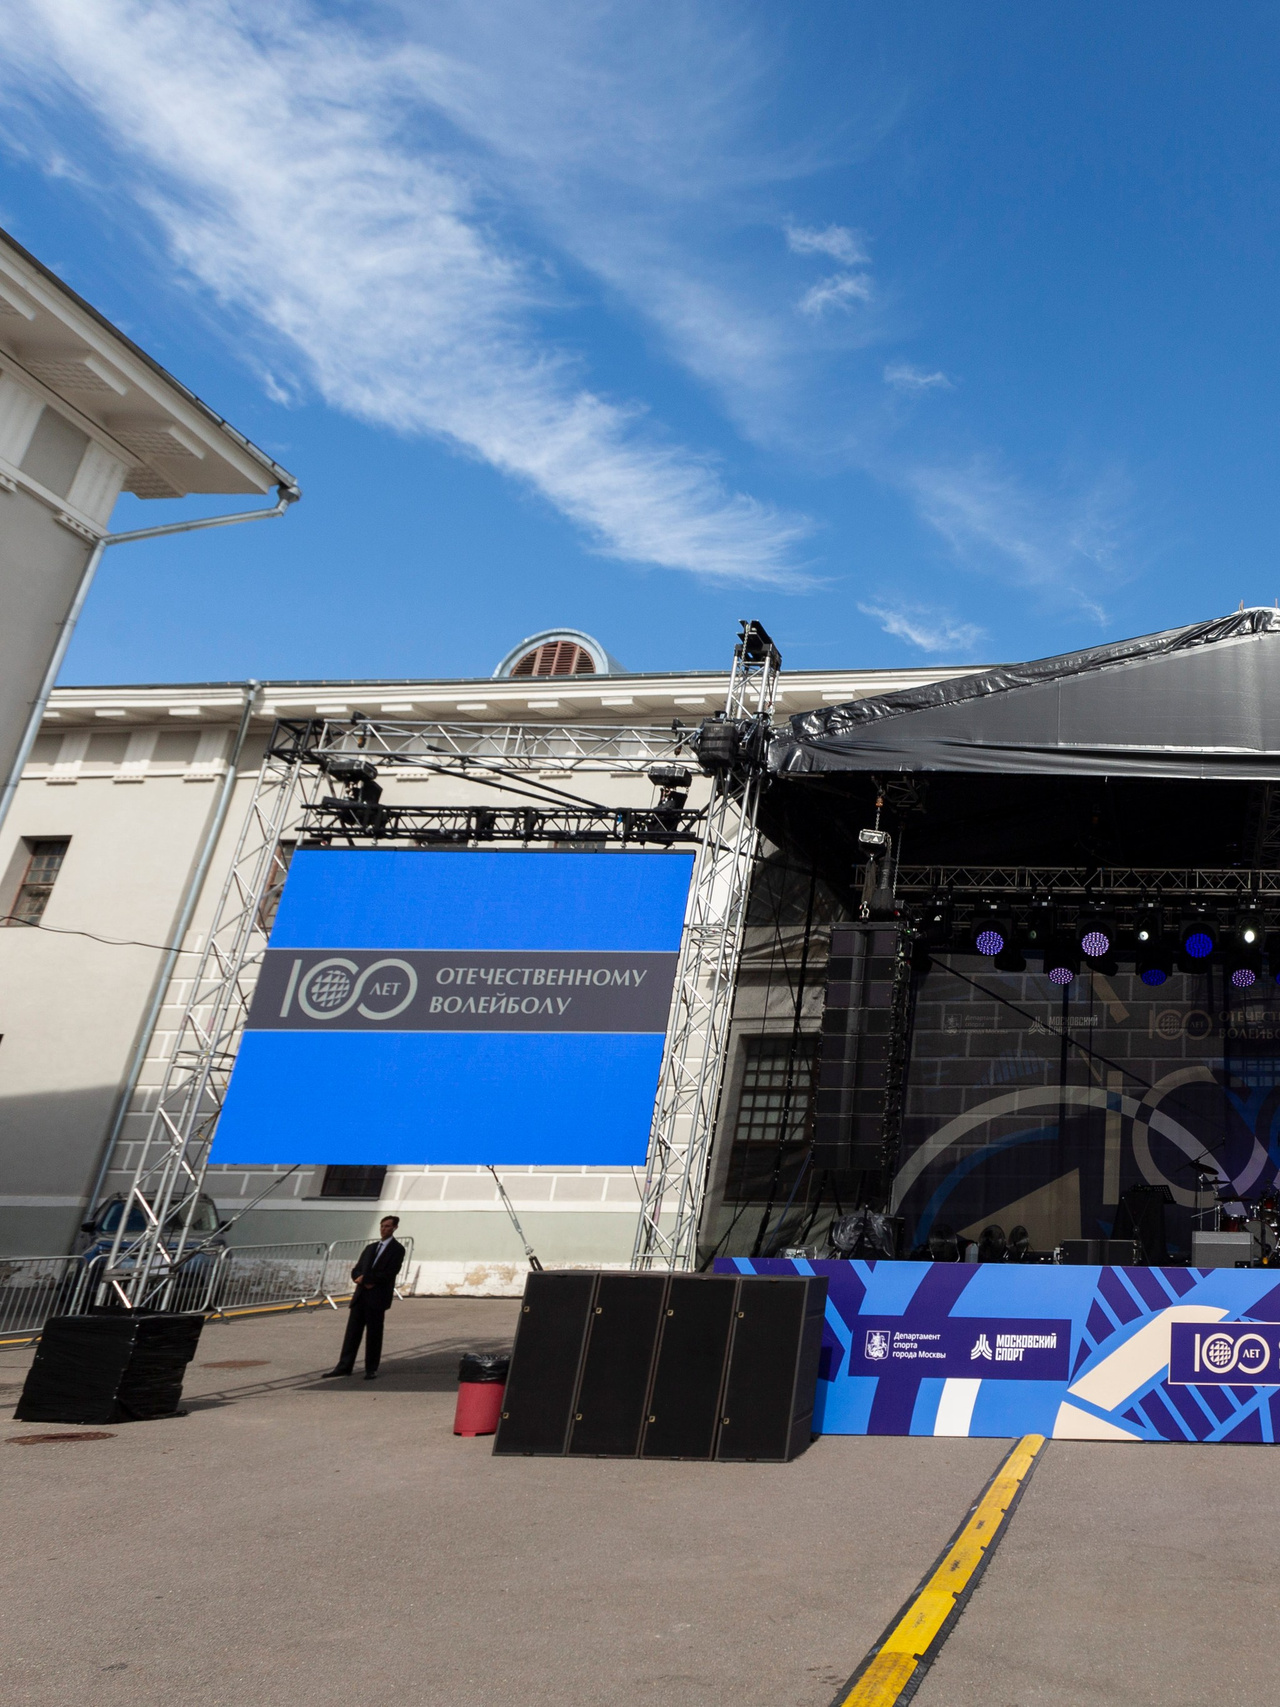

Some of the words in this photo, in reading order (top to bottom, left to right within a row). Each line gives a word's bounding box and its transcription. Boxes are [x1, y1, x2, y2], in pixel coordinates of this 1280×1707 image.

[435, 967, 648, 988] ОТЕЧЕСТВЕННОМУ
[369, 982, 402, 997] ЛЕТ
[428, 992, 572, 1016] ВОЛЕЙБОЛУ
[893, 1332, 941, 1342] Департамент
[996, 1333, 1057, 1349] МОСКОВСКИЙ
[893, 1342, 918, 1351] спорта
[892, 1351, 917, 1360] города
[918, 1350, 947, 1359] Москвы
[995, 1348, 1025, 1361] СПОРТ
[1242, 1348, 1261, 1359] ЛЕТ
